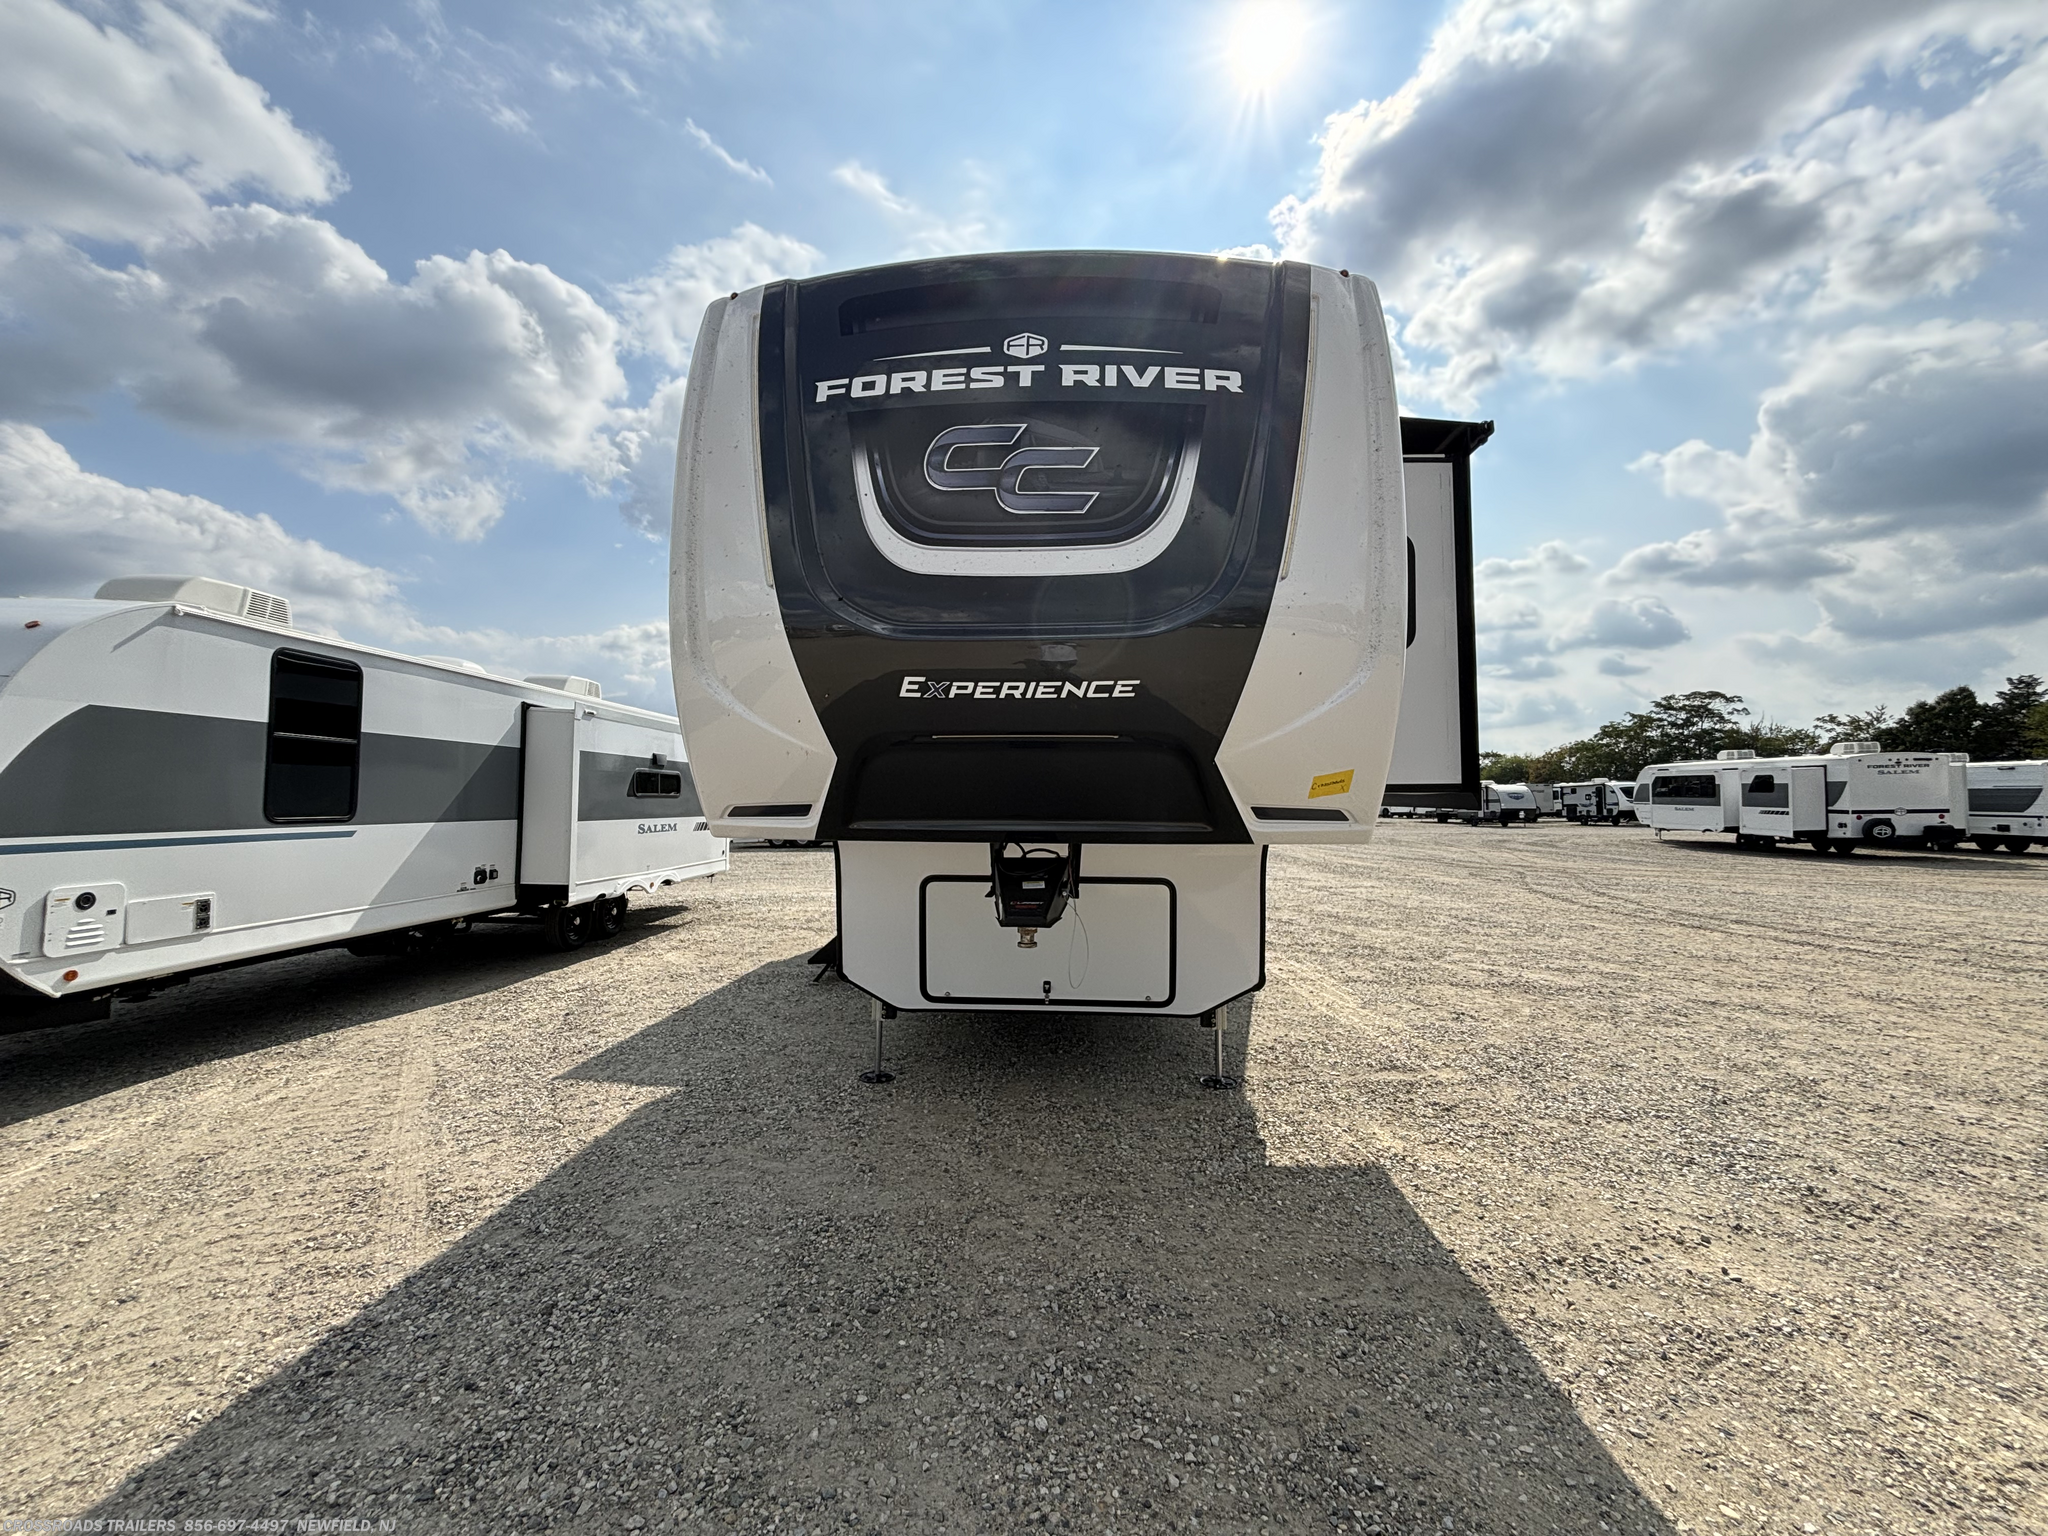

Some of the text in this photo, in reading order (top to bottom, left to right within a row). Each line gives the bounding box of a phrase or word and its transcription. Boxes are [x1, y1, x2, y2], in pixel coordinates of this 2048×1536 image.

[815, 364, 1244, 403] FOREST RIVER
[923, 423, 1101, 515] CC
[899, 676, 1141, 699] EXPERIENCE
[637, 823, 678, 835] SALEM
